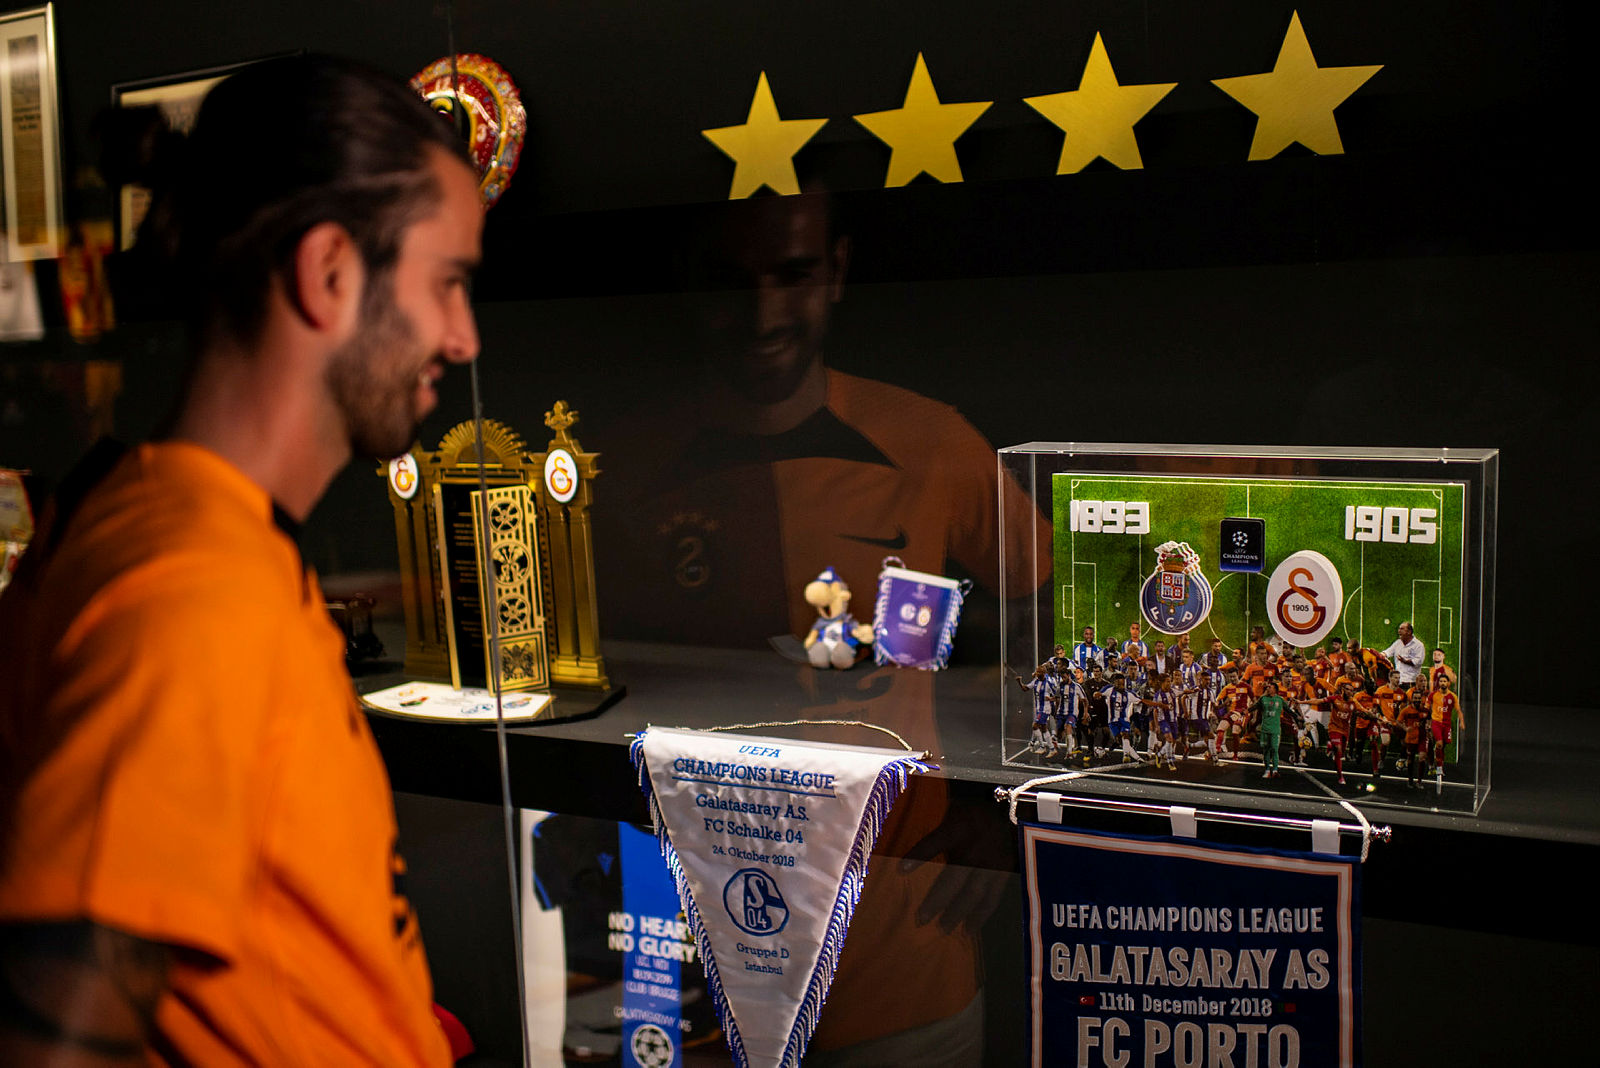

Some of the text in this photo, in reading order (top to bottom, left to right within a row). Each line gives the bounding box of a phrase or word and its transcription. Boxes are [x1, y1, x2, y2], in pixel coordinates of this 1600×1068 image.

[1070, 500, 1150, 534] 1893
[1345, 506, 1437, 544] 1905
[1292, 604, 1309, 612] 1905
[738, 745, 782, 758] UEFA
[673, 757, 835, 790] CHAMPIONS LEAGUE
[696, 794, 781, 819] Galatasaray
[704, 818, 804, 844] FC Schalke 04
[712, 845, 795, 867] 24. Oktober 2018
[607, 912, 690, 941] NO HEAR
[1052, 903, 1324, 934] UEFA CHAMPIONS LEAGUE
[607, 932, 696, 963] NO GLORY
[736, 942, 790, 959] Gruppe D
[744, 961, 783, 975] Istanbul
[1050, 942, 1330, 990] GALATASARAY AS
[1099, 992, 1273, 1018] 11th December 2018
[1077, 1016, 1300, 1068] FC PORTO
